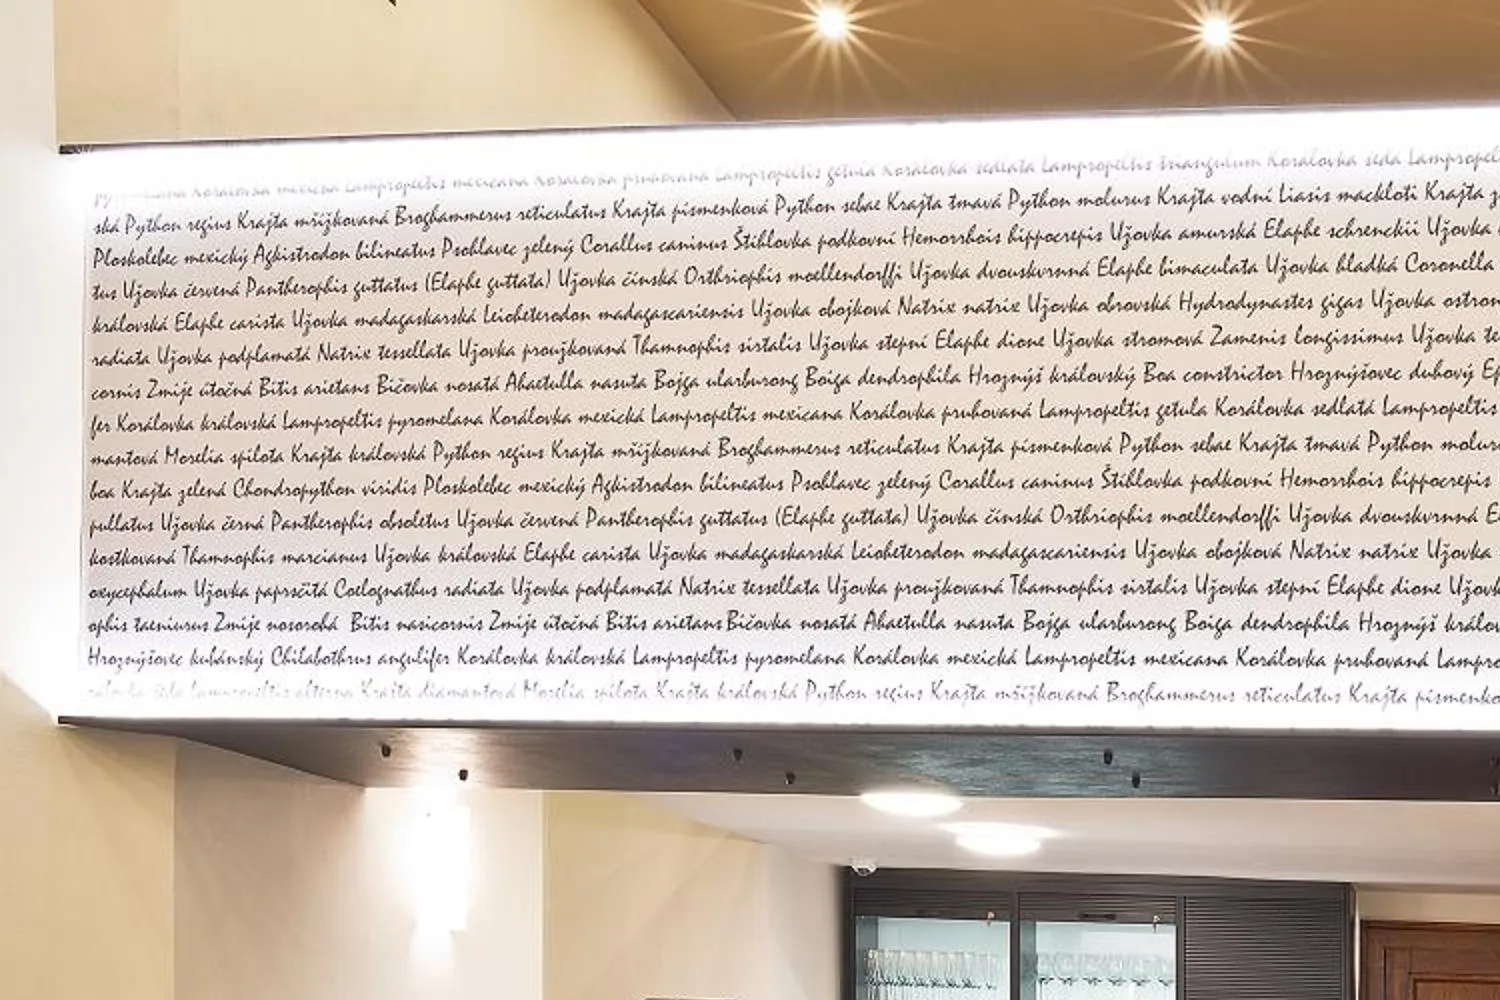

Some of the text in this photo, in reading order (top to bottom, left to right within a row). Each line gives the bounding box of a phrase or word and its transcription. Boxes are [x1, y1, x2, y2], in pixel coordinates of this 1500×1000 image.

[125, 214, 181, 240] Python
[188, 216, 231, 239] regius
[238, 210, 288, 237] Krajta
[395, 204, 511, 232] Broghammerus
[516, 200, 606, 221] reticulatus
[612, 198, 666, 226] Krajta
[775, 194, 835, 222] Python
[842, 192, 880, 213] sebae
[887, 191, 942, 218] Krajta
[1008, 188, 1070, 217] Python
[1076, 187, 1150, 206] molurus
[1158, 184, 1215, 213] Krajta
[1279, 183, 1330, 203] Liasis
[1336, 181, 1417, 202] mackloti
[1425, 180, 1484, 208] Krajta
[174, 311, 224, 337] Elaphe
[598, 301, 744, 329] madagascariensis
[897, 294, 956, 316] Natrix
[962, 297, 1020, 315] natrix
[1180, 290, 1313, 319] Hydrodynastes
[1320, 293, 1363, 318] gigas
[90, 414, 112, 441] fer
[282, 408, 382, 436] Lampropeltis
[388, 406, 483, 435] pyromelana
[652, 402, 756, 430] Lampropeltis
[762, 406, 843, 422] mexicana
[1040, 397, 1150, 426] Lampropeltis
[1156, 396, 1208, 426] getula
[1382, 394, 1498, 423] Lampropeltis
[90, 512, 154, 539] pullatus
[271, 509, 372, 536] Pantherophis
[379, 509, 449, 530] obsoletus
[586, 506, 693, 533] Pantherophis
[700, 510, 768, 535] guttatus
[776, 505, 835, 532] (Elaphe
[842, 504, 908, 534] guttata)
[1050, 504, 1152, 530] Orthriophis
[88, 612, 127, 638] ophis
[134, 617, 208, 632] taeniurus
[351, 611, 389, 632] Bitis
[396, 616, 483, 632] nasicornis
[606, 610, 647, 632] Bitis
[864, 608, 946, 632] Ahaetulla
[954, 614, 1014, 630] nasuta
[1184, 610, 1232, 640] Boiga
[1241, 610, 1349, 638] dendrophila
